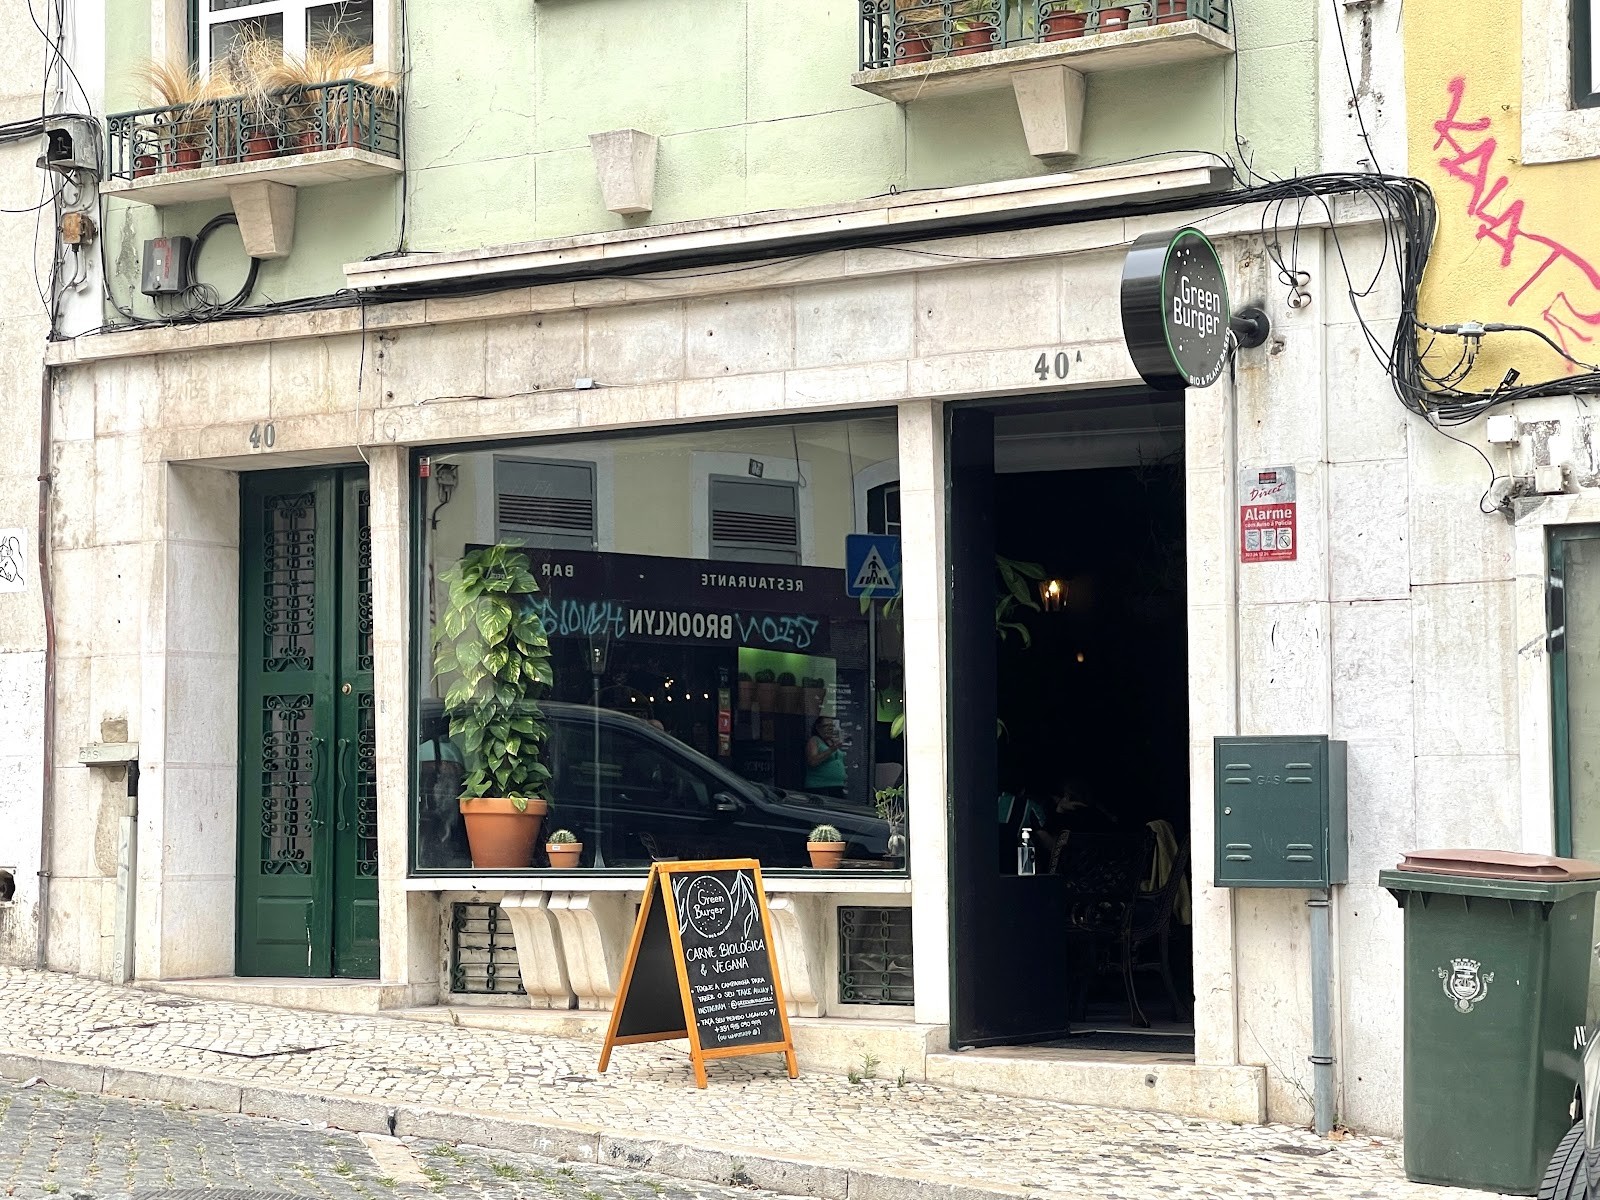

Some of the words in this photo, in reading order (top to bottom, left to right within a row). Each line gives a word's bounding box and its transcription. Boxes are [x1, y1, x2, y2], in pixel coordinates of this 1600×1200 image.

[1181, 275, 1221, 313] Green
[1173, 296, 1220, 338] Burger
[1189, 374, 1200, 386] BIO
[1201, 376, 1206, 385] &
[1205, 360, 1221, 383] PLANT
[1220, 326, 1230, 363] BASED
[249, 422, 275, 449] 40
[1249, 482, 1286, 501] Direct
[1245, 508, 1292, 521] Alarme
[79, 750, 99, 760] GAS
[1257, 774, 1280, 785] GAS
[698, 889, 724, 906] Green
[693, 904, 725, 920] Burger
[686, 946, 717, 962] CARNE
[719, 936, 765, 958] BIOLÓGICA
[700, 963, 708, 977] &
[712, 957, 749, 974] VEGANA
[695, 984, 714, 993] TOQUE
[751, 977, 765, 985] PARA
[736, 988, 752, 997] TAKE
[715, 1016, 725, 1024] SEU
[745, 1011, 768, 1019] LIGANDO
